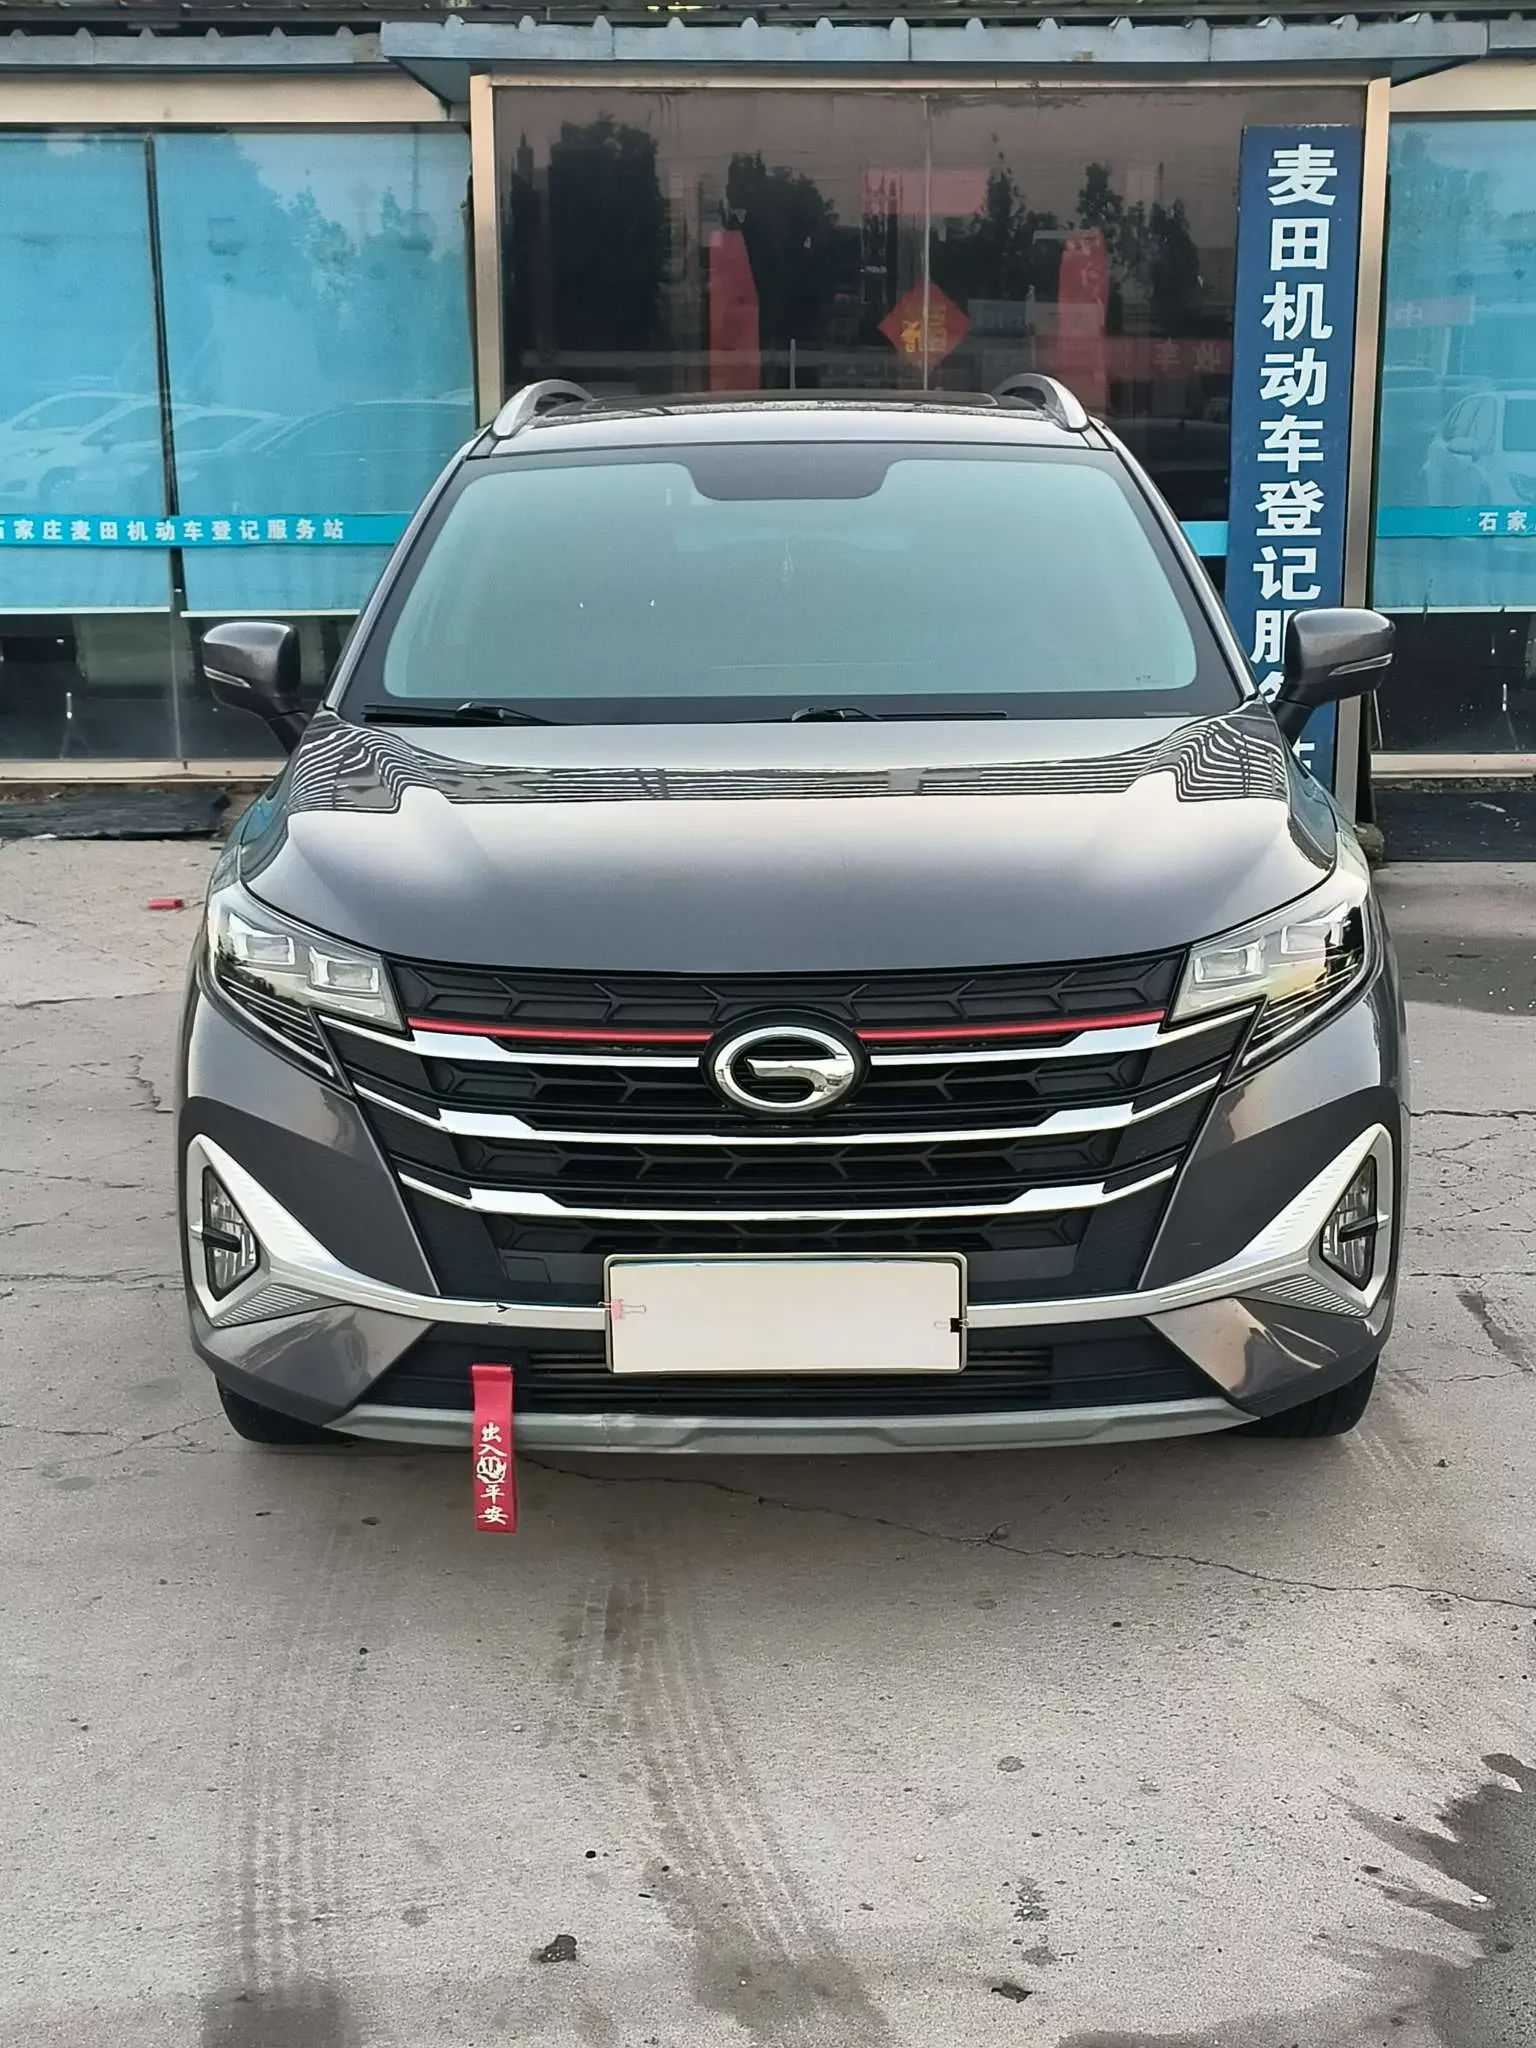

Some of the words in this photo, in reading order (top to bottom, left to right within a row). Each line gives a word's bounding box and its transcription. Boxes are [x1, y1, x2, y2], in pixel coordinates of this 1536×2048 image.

[0, 519, 344, 541] 家庄麦田机动车登记服务站
[1250, 143, 1338, 771] 麦田机动车登记服
